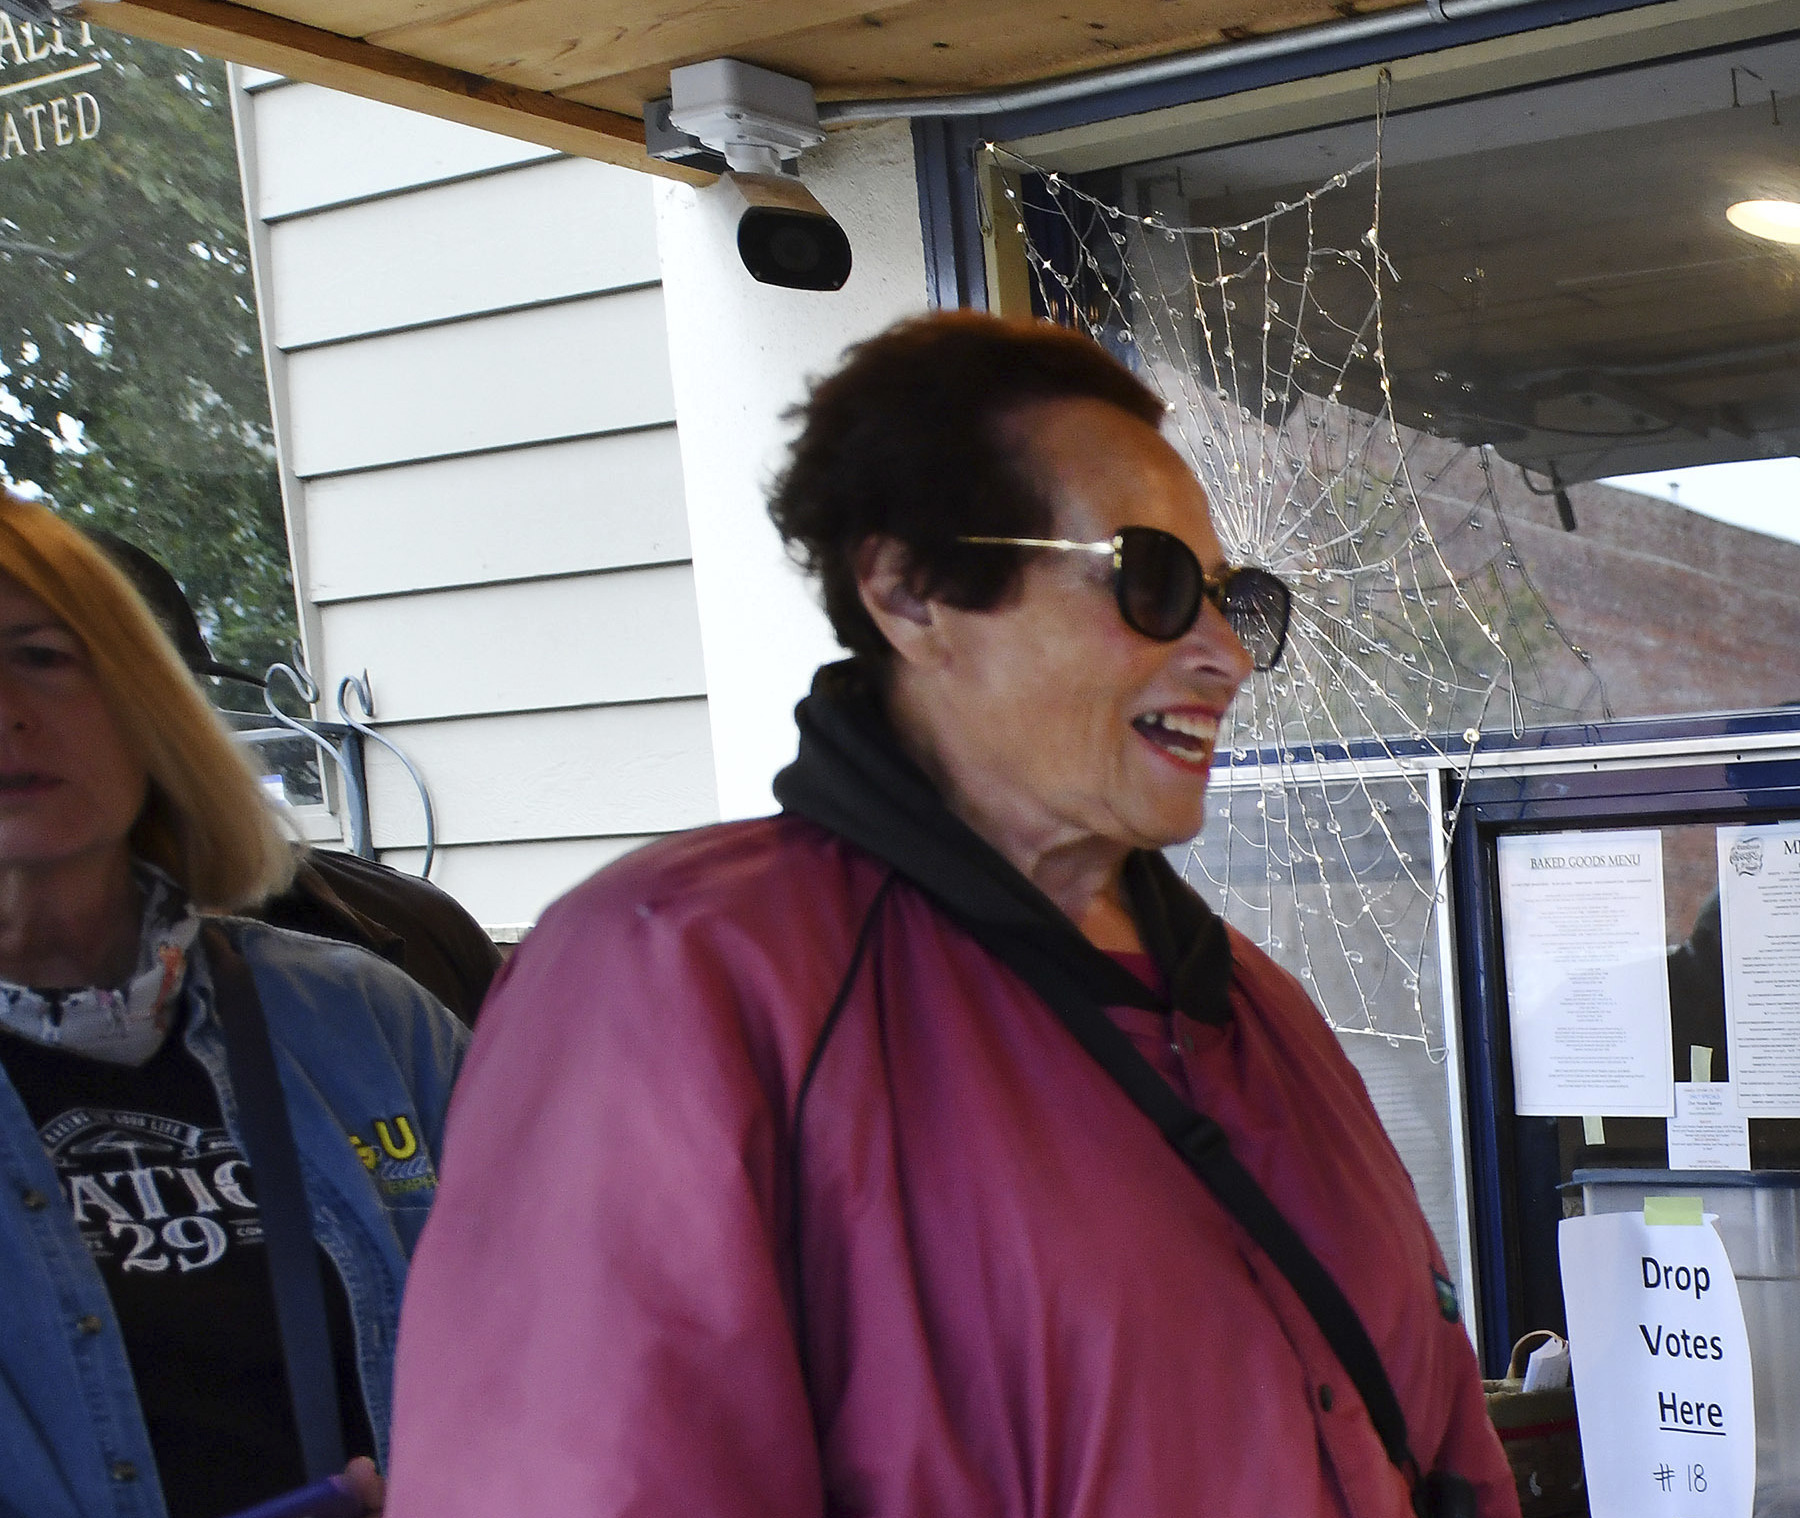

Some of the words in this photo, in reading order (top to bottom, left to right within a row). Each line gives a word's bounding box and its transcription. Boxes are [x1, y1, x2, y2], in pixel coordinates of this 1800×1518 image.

[1530, 857, 1565, 870] BAKED
[1568, 855, 1605, 869] GOODS
[1608, 854, 1641, 867] MENU
[108, 1215, 227, 1273] 29
[1641, 1256, 1711, 1300] Drop
[1639, 1324, 1724, 1361] Votes
[1658, 1391, 1724, 1428] Here
[1653, 1463, 1675, 1492] #
[1687, 1463, 1708, 1493] 18
